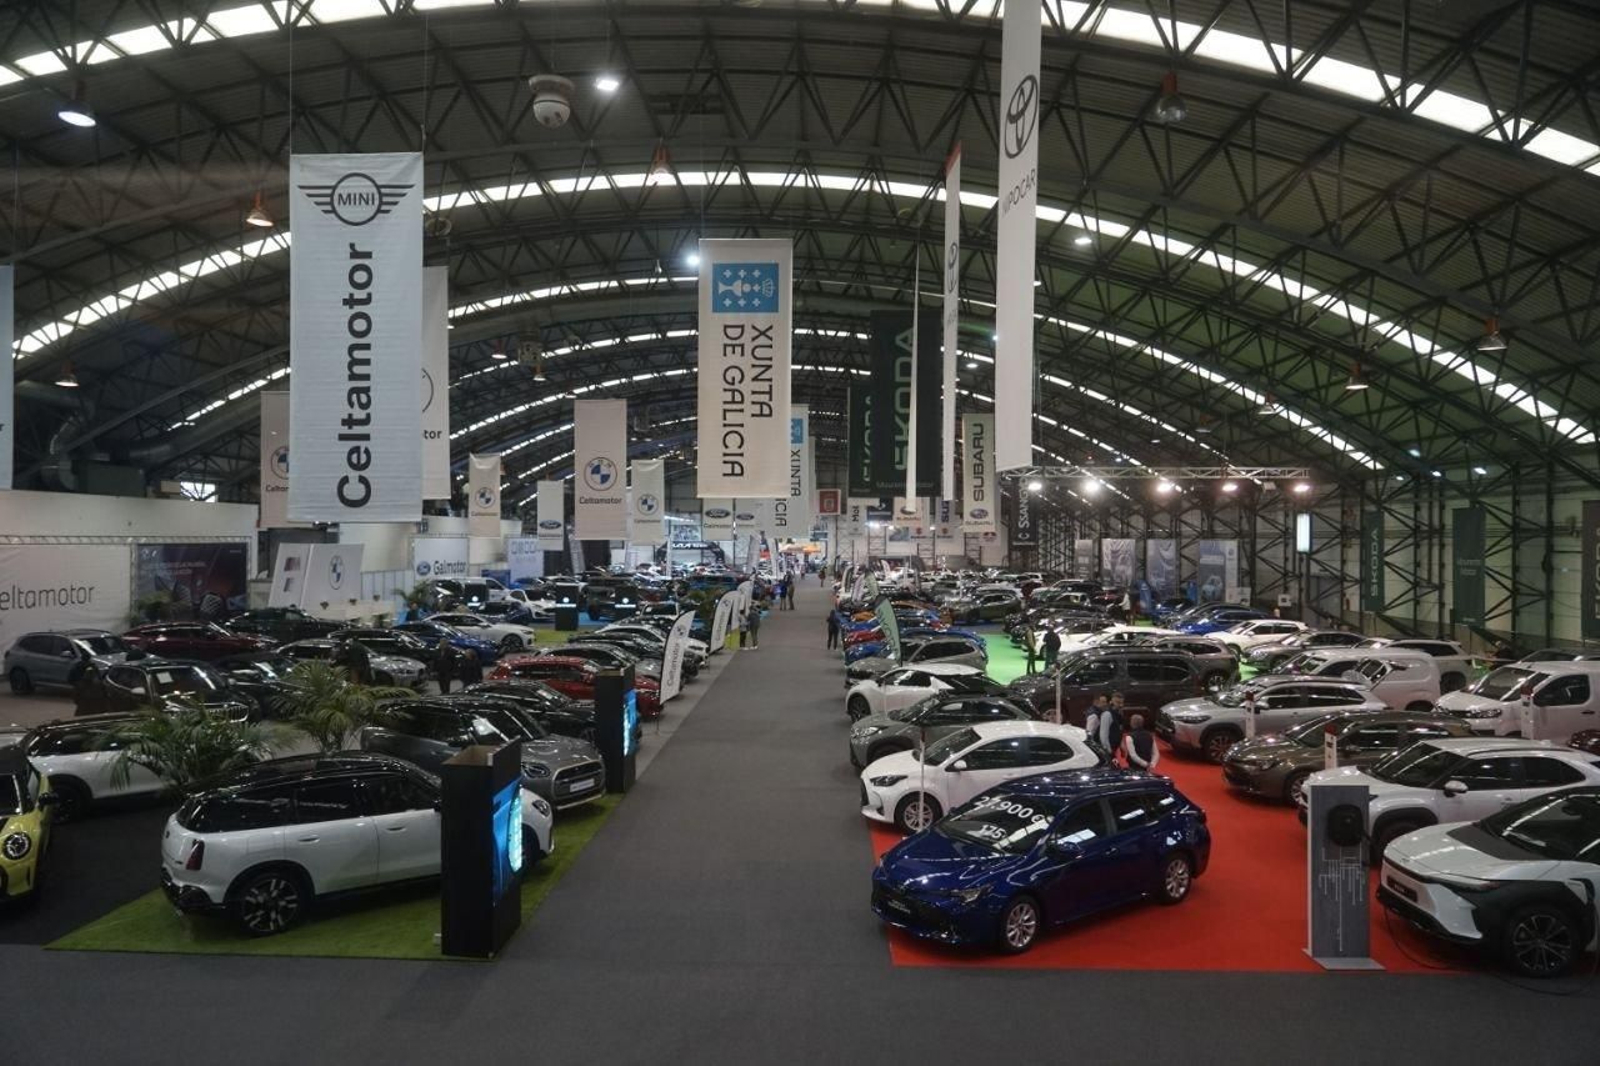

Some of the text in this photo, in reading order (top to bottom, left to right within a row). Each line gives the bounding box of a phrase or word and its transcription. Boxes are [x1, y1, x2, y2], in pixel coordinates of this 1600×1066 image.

[338, 192, 376, 207] MINI
[337, 242, 374, 509] Celtamotor
[722, 323, 746, 478] DE GALICIA
[751, 323, 774, 419] XUNTA
[790, 449, 802, 498] XUNTA
[972, 422, 985, 502] SUBARU
[579, 496, 623, 505] Celtamotor
[433, 560, 467, 575] Galmotor
[1371, 529, 1379, 597] SKODA
